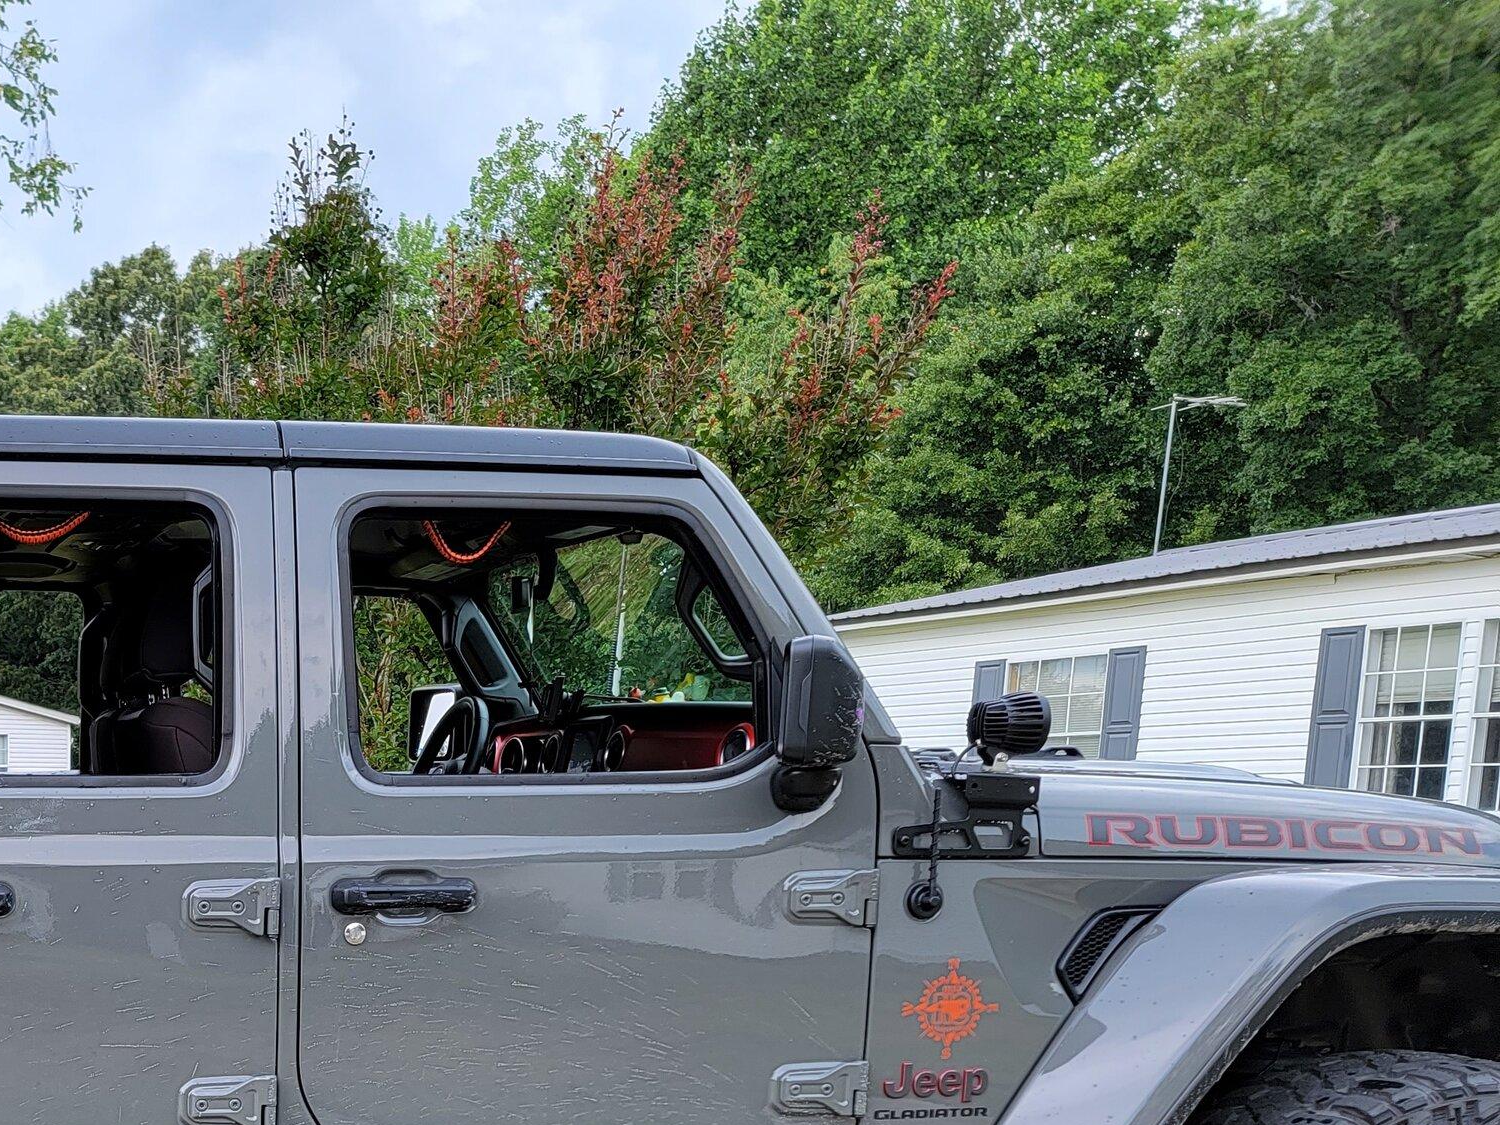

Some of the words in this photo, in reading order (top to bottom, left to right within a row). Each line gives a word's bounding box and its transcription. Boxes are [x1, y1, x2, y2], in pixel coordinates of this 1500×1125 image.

[1085, 813, 1482, 856] RUBICON
[883, 1060, 989, 1103] Jeep
[874, 1107, 988, 1120] GLADIATOR
